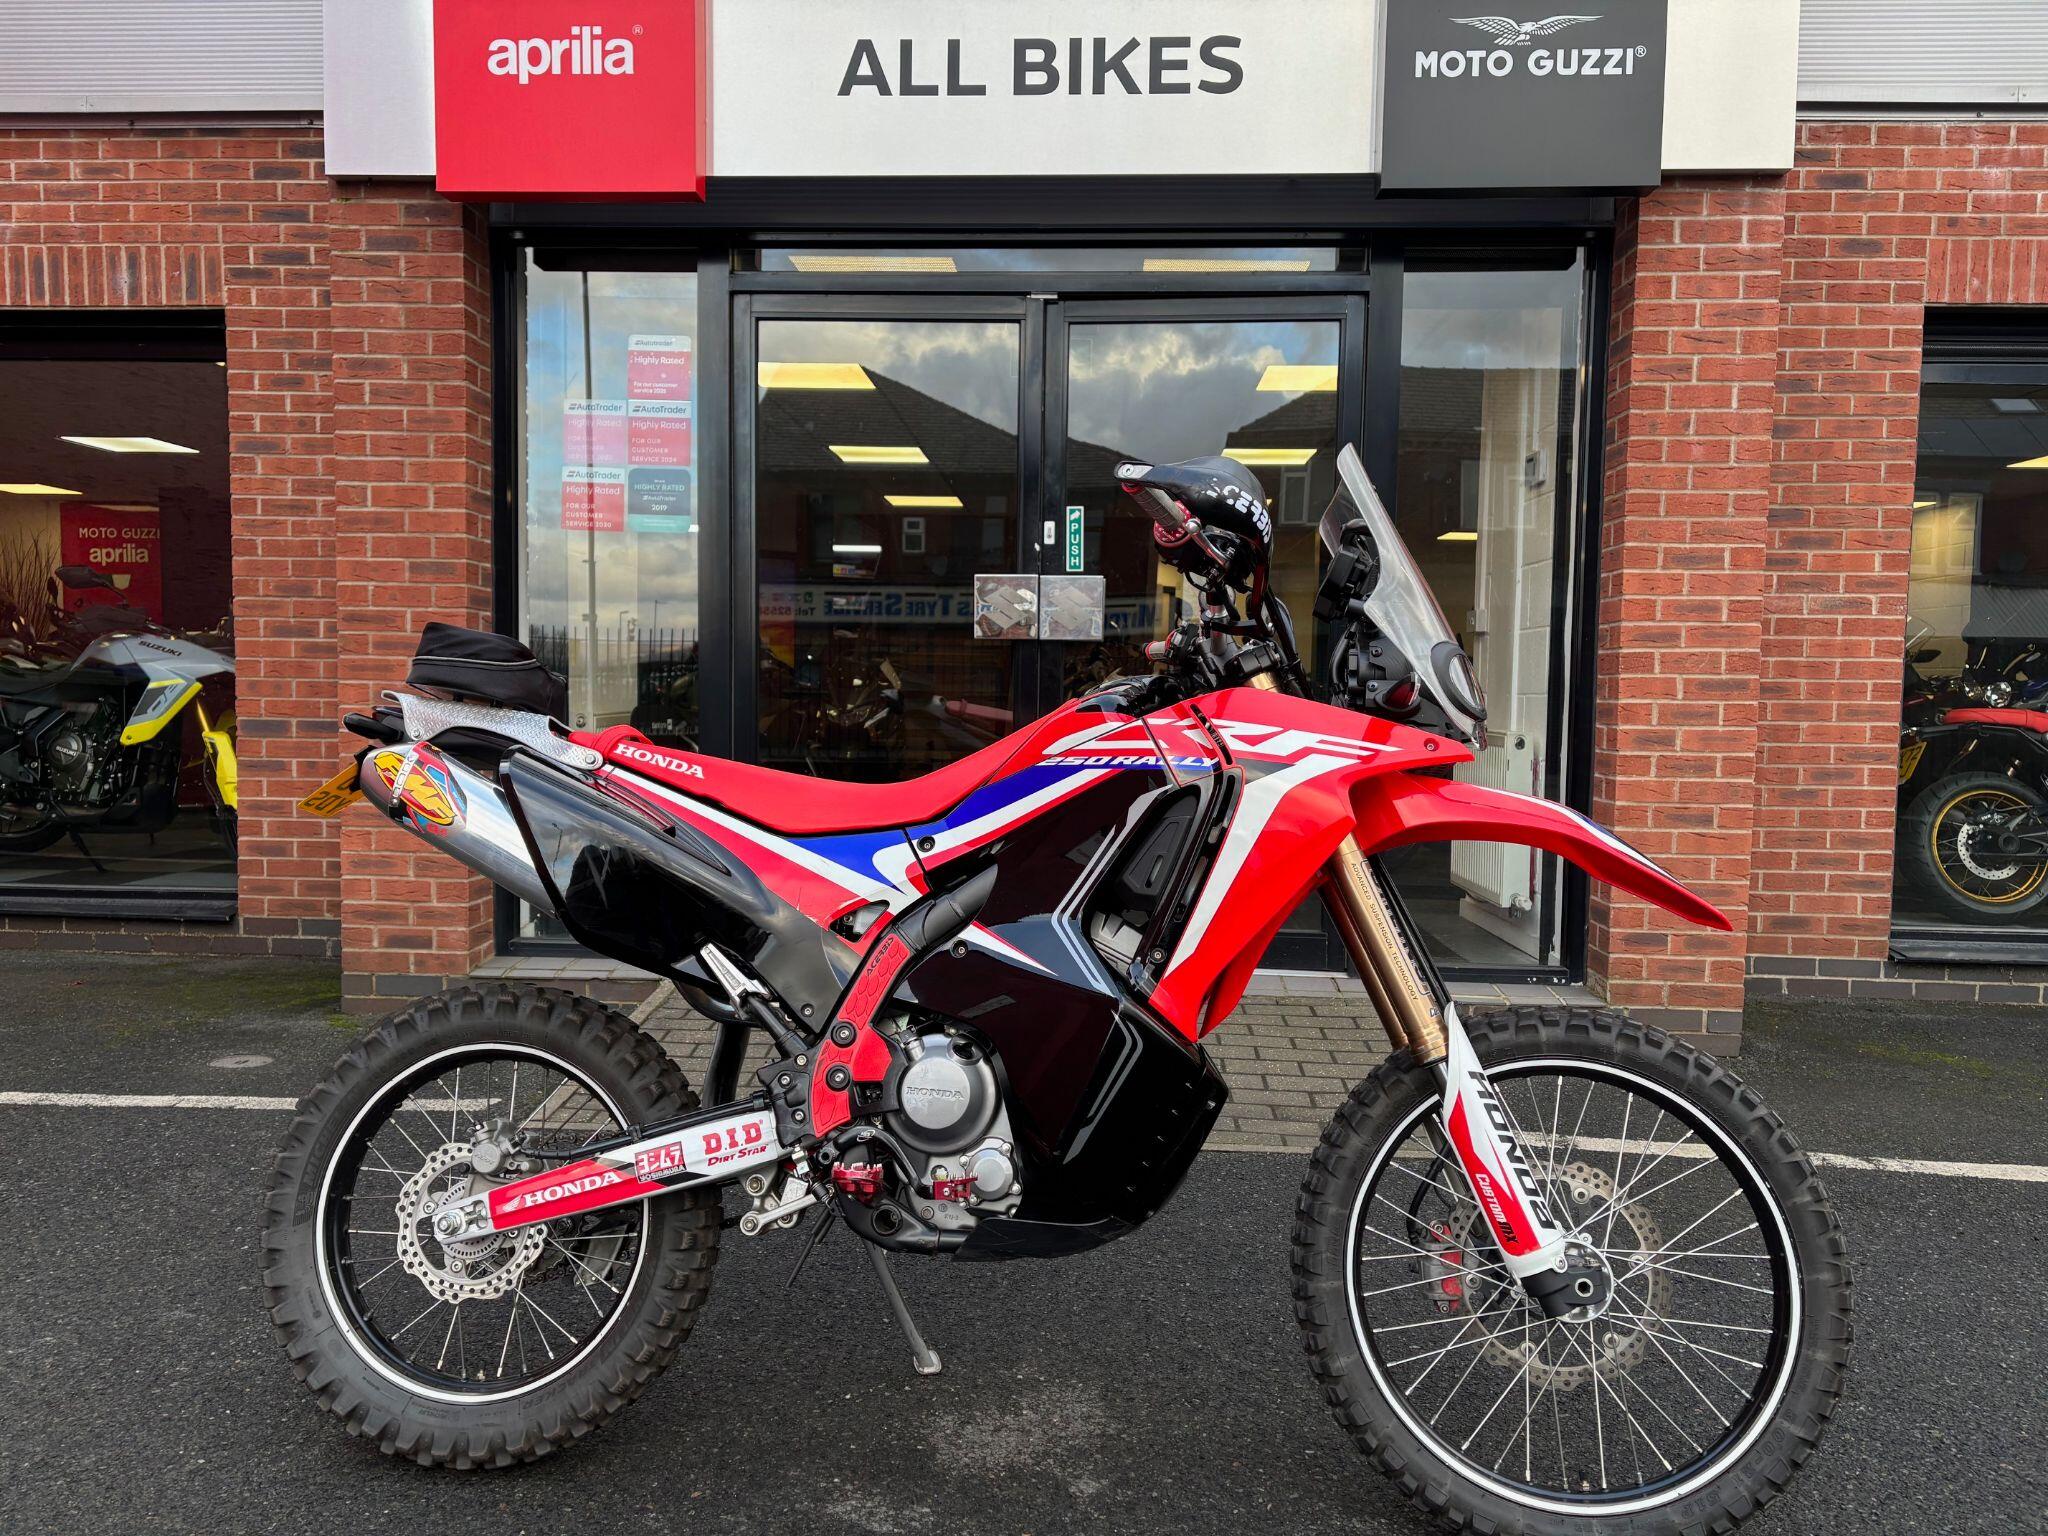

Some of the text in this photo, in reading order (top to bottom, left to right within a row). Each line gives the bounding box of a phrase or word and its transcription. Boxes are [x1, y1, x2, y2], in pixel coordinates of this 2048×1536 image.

[487, 26, 634, 85] aprilia
[1415, 47, 1634, 78] MOTO GUZZI
[837, 34, 1244, 97] ALL BIKES
[634, 356, 685, 366] Highly Rated
[641, 405, 687, 414] AutoTrader
[632, 420, 686, 431] Highly Rated
[574, 471, 622, 480] AutoTrader
[595, 487, 620, 495] Rated
[634, 484, 661, 492] HIGHLY
[79, 527, 160, 539] MOTO GUZZI
[1071, 523, 1080, 567] PUSH
[89, 543, 149, 567] aprilia
[138, 640, 183, 657] SUZUKI
[56, 745, 77, 757] SUZUKI
[614, 742, 705, 780] HONDA
[1350, 862, 1373, 901] ADVANCED
[1369, 902, 1394, 951] SUSPENSION
[1391, 951, 1420, 1001] TECHNOLOGY
[906, 1086, 965, 1100] HONDA
[1467, 1070, 1558, 1231] HONDA
[637, 1145, 681, 1175] ヨシムラ
[640, 1164, 686, 1182] YOSHIMURA
[523, 1170, 623, 1208] HONDA
